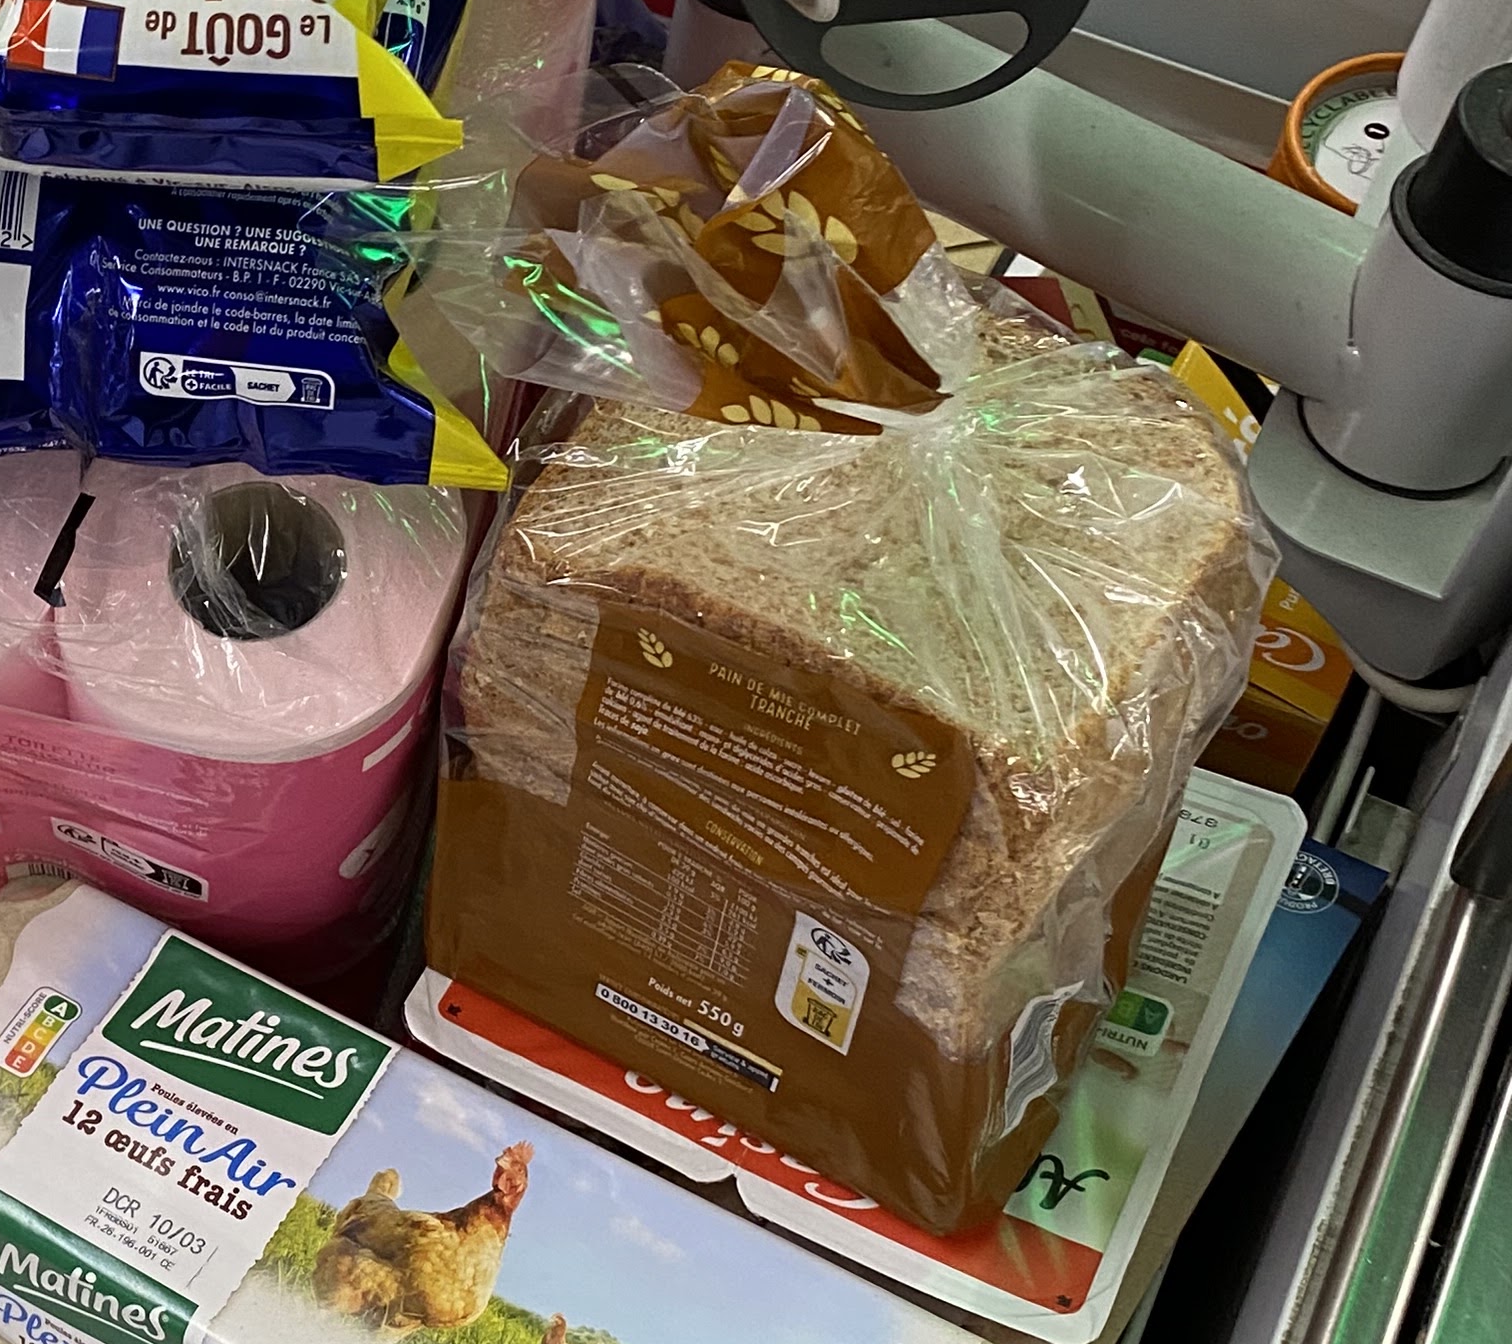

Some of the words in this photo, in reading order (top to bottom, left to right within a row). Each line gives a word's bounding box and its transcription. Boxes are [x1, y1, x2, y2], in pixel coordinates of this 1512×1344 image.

[146, 11, 176, 39] de
[180, 12, 291, 66] GOÛT
[300, 14, 330, 44] Le
[138, 218, 163, 230] UNE
[166, 220, 230, 237] QUESTION
[245, 226, 271, 238] UNE
[195, 236, 220, 249] UNE
[224, 238, 296, 255] REMARQUE
[135, 249, 213, 267] Contactez-nous
[223, 255, 298, 273] INTERSNACK
[140, 263, 223, 281] Consommateurs
[289, 276, 326, 290] 02290
[157, 284, 221, 298] www.vico.fr
[224, 290, 331, 308] conso@intersnack.fr
[171, 300, 210, 318] joindre
[307, 315, 332, 328] date
[223, 320, 249, 334] code
[286, 327, 326, 343] produit
[200, 382, 232, 390] FACILE
[247, 381, 280, 393] SACHET
[709, 662, 744, 685] PAIN
[747, 677, 765, 696] DE
[769, 685, 794, 708] MIE
[798, 701, 862, 736] COMPLET
[749, 694, 813, 732] TRANCHÉ
[705, 820, 765, 866] CONSERVATION
[814, 963, 849, 986] SACHET
[648, 977, 674, 999] Poids
[676, 993, 692, 1007] net
[697, 999, 733, 1027] 550
[808, 978, 846, 1004] FERMOIR
[3, 992, 47, 1045] NUTRI-SCORE
[612, 992, 639, 1014] 800
[641, 1008, 659, 1024] 13
[660, 1018, 679, 1034] 30
[682, 1030, 700, 1046] 16
[130, 987, 357, 1090] Matines
[150, 1083, 185, 1110] Poules
[186, 1101, 225, 1129] élevées
[77, 1055, 207, 1155] Plein
[203, 1137, 296, 1198] Air
[62, 1098, 104, 1137] 12
[103, 1128, 176, 1178] œufs
[176, 1166, 253, 1218] frais
[102, 1186, 141, 1219] DCR
[148, 1214, 208, 1255] 10/03
[44, 1317, 74, 1341] Poules
